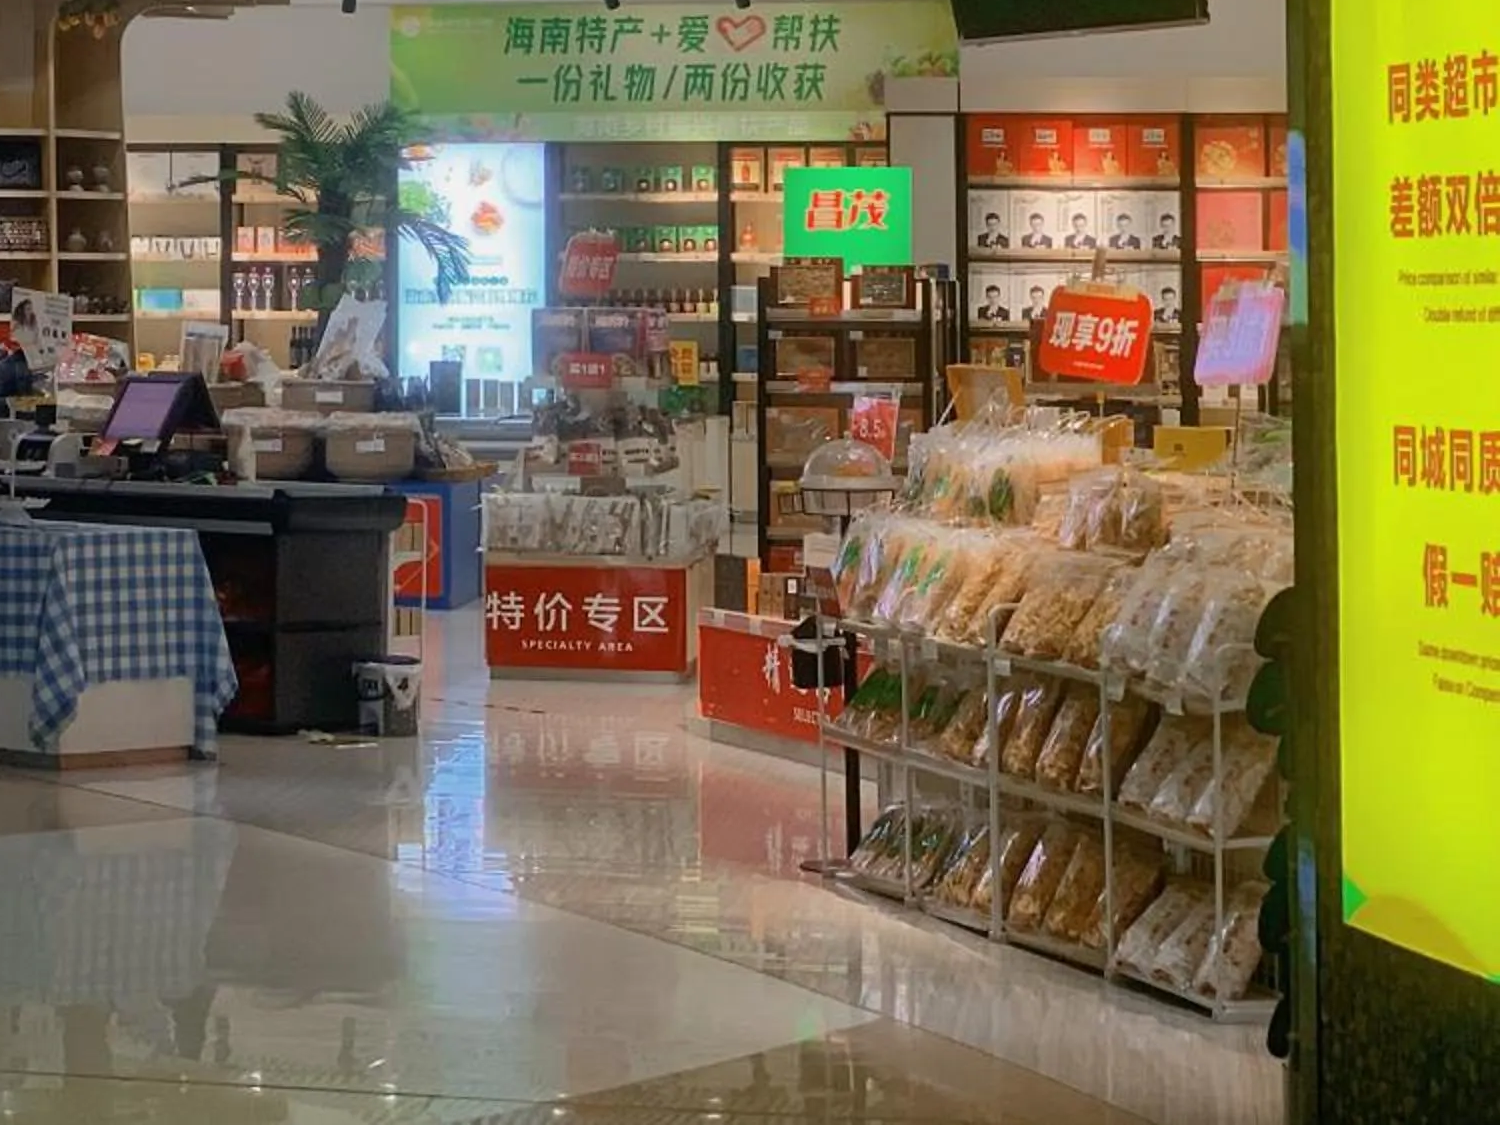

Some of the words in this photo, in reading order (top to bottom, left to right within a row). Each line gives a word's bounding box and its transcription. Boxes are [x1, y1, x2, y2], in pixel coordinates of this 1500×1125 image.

[516, 62, 828, 104] 一份礼物/两份收获
[1387, 49, 1498, 124] 同类超市
[805, 189, 891, 232] 昌茂
[1389, 169, 1500, 240] 差额双倍
[1393, 424, 1500, 495] 同城同质
[1422, 542, 1500, 619] 假一赔
[484, 590, 670, 634] 特价专区
[521, 638, 592, 652] SPECIALTY
[597, 641, 634, 653] AREA
